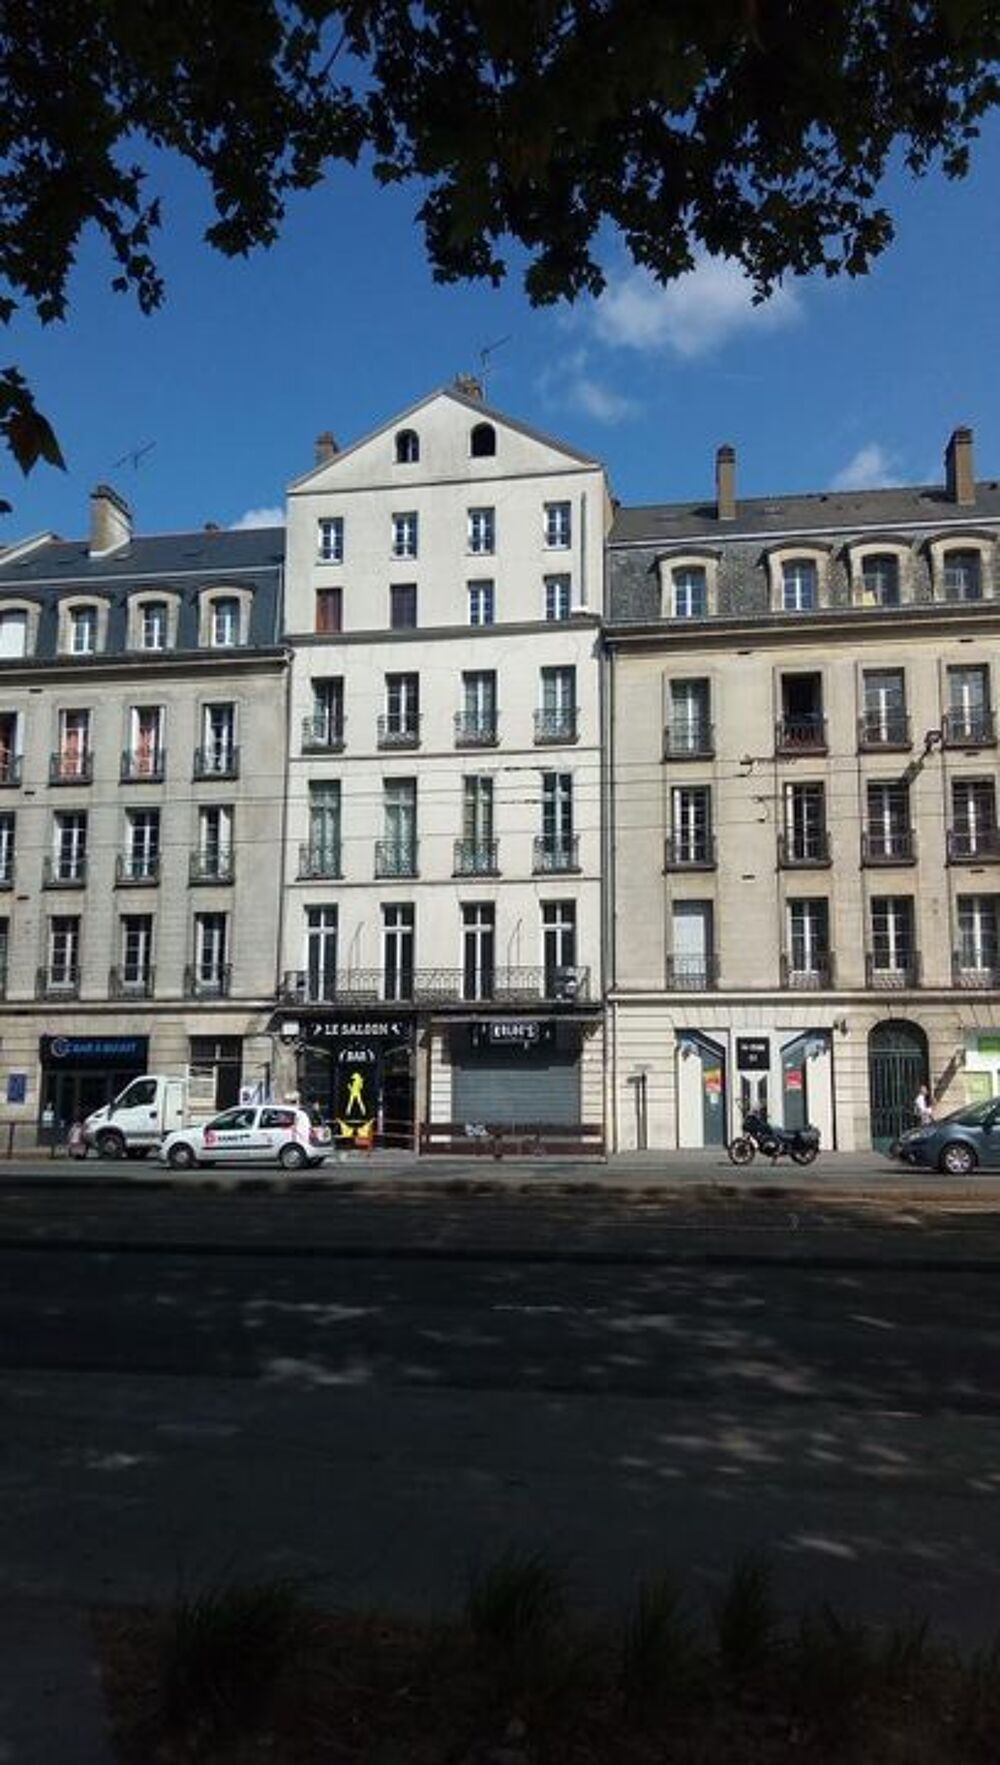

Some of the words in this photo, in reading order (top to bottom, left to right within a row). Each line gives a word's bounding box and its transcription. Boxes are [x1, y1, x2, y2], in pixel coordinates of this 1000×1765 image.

[325, 1024, 339, 1035] LE
[341, 1023, 388, 1035] SALOON
[346, 1050, 367, 1061] BAR
